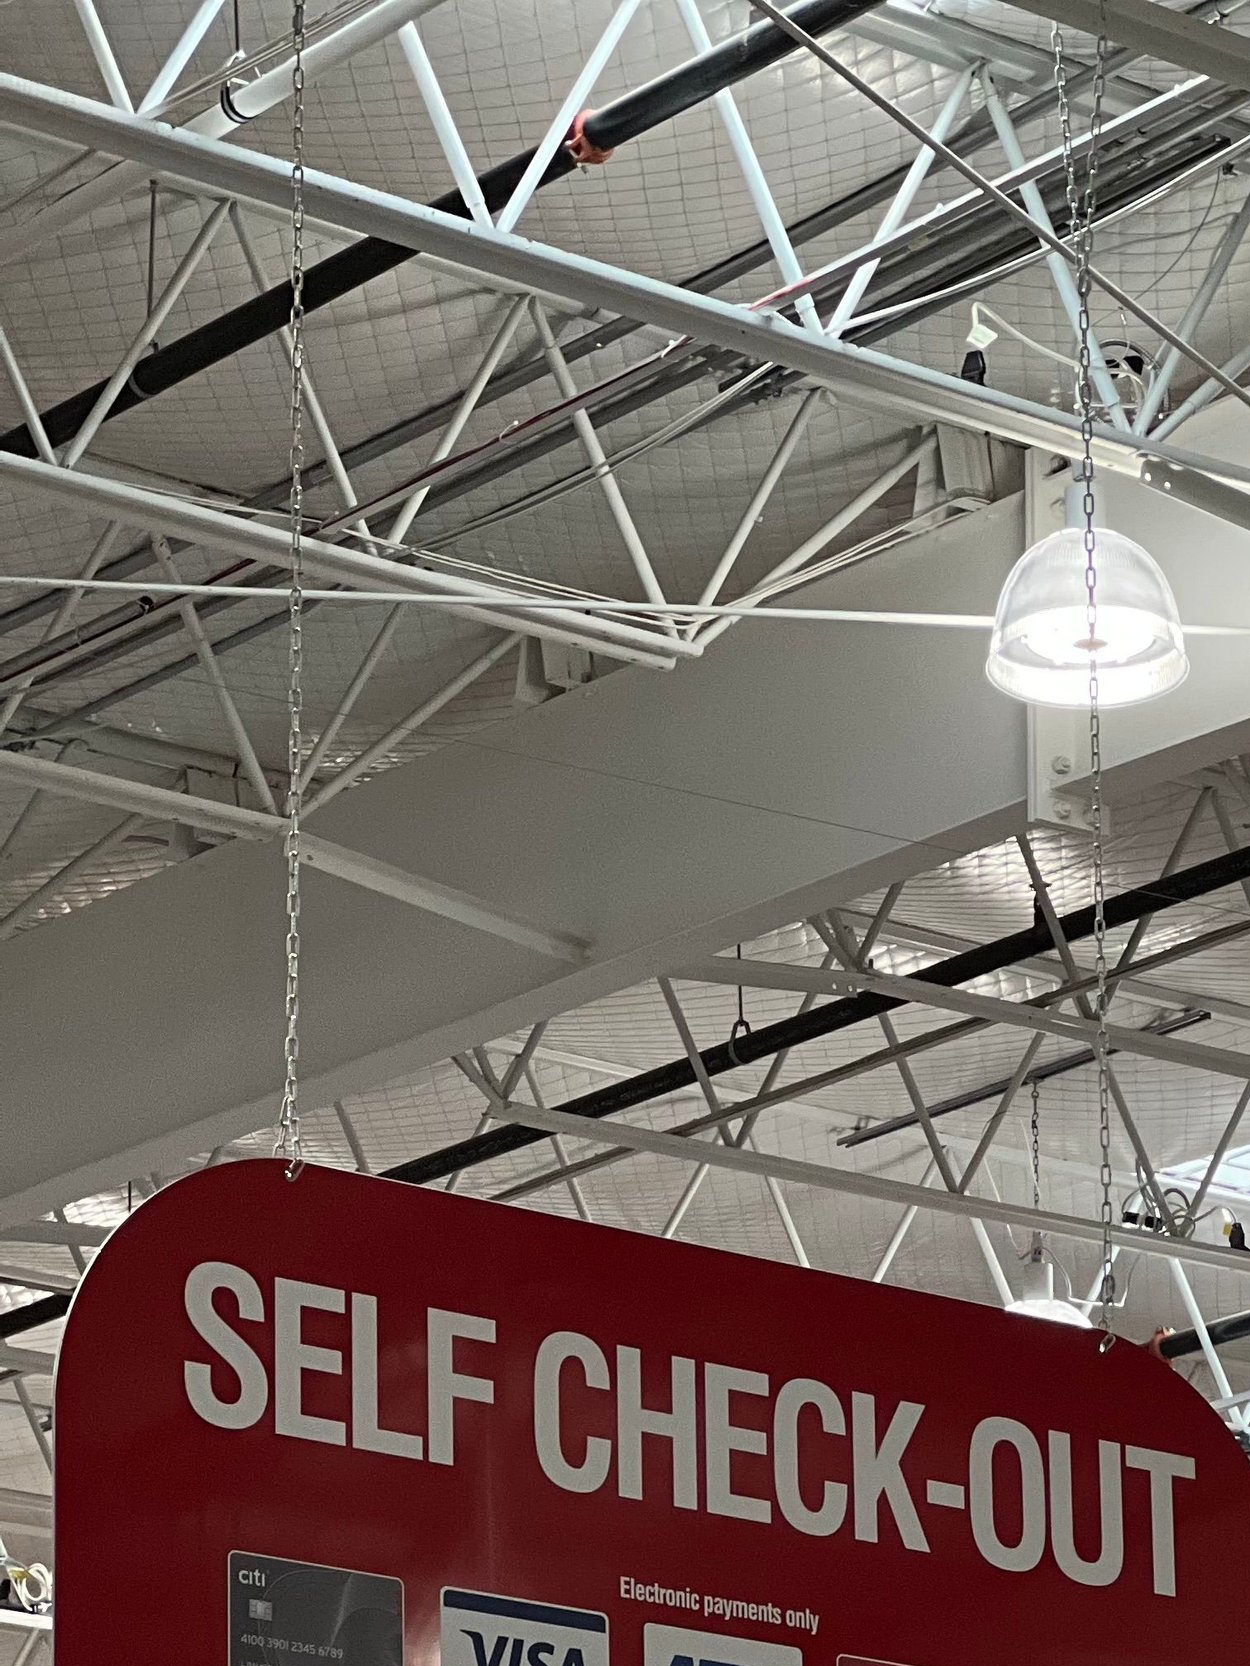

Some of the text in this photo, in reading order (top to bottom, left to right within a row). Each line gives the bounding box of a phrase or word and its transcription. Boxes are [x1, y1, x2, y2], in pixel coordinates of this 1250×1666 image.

[184, 1261, 1196, 1597] SELF CHECK-OUT
[238, 1569, 266, 1587] citi
[620, 1576, 820, 1635] Electronic payments only
[291, 1641, 316, 1655] 2345
[318, 1646, 344, 1659] 6789
